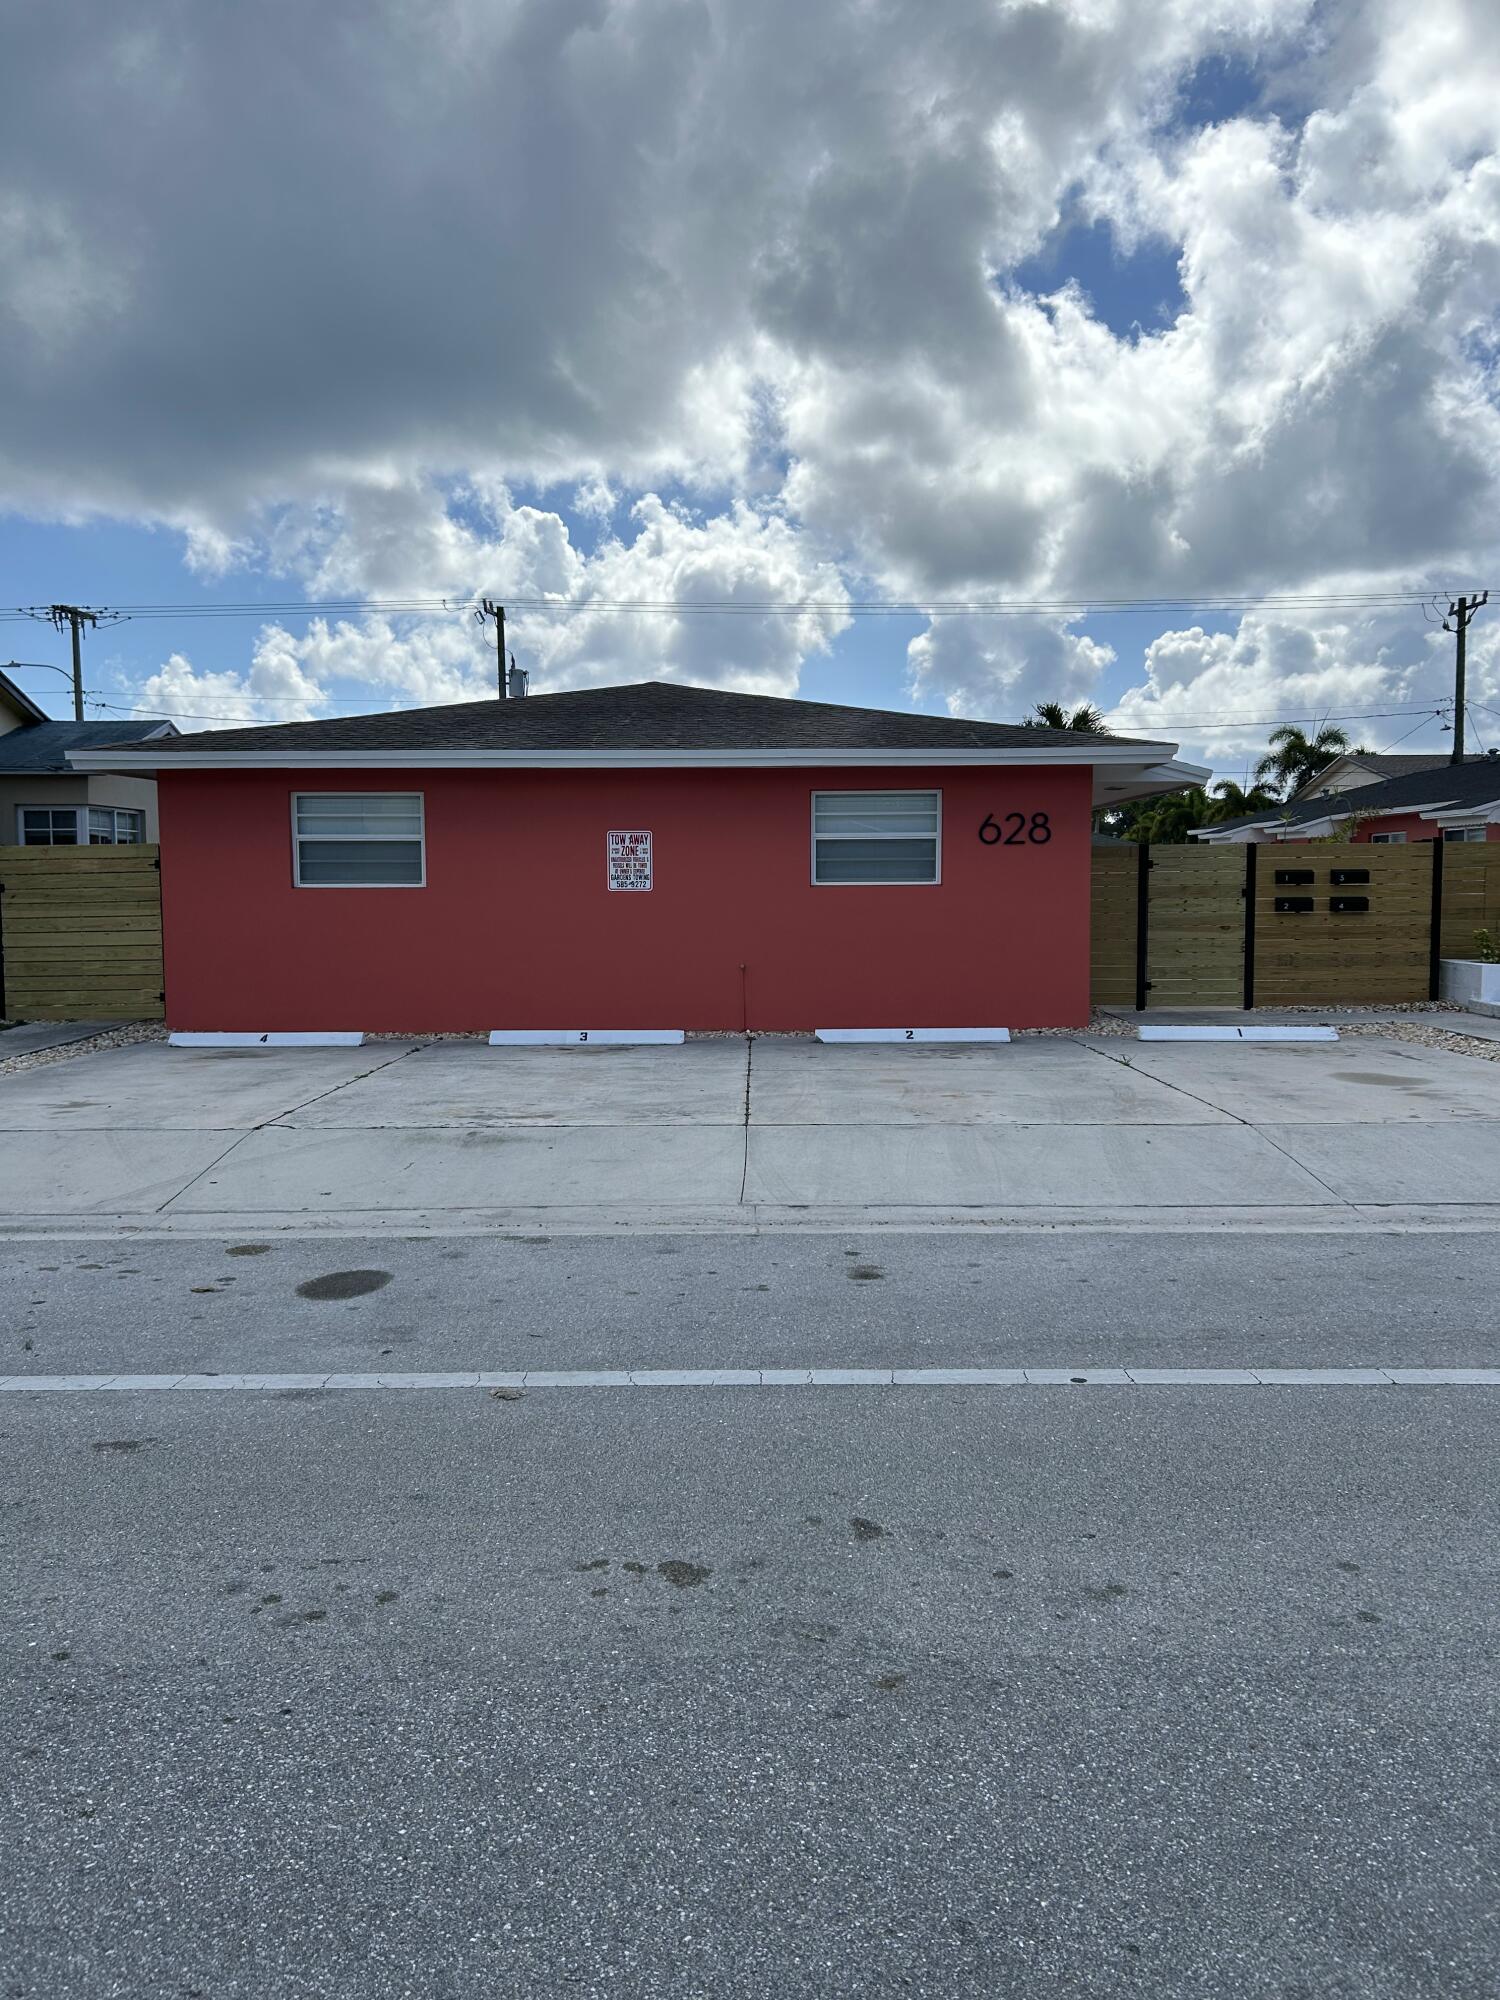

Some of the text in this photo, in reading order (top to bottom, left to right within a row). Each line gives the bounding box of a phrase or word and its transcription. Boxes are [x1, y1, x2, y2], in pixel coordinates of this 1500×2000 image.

[978, 812, 1051, 845] 628
[611, 834, 649, 845] TOW AWAY
[621, 846, 639, 856] ZONE
[579, 1031, 588, 1041] 3
[905, 1030, 914, 1040] 2
[1237, 1028, 1243, 1037] 1
[260, 1033, 268, 1043] 4
